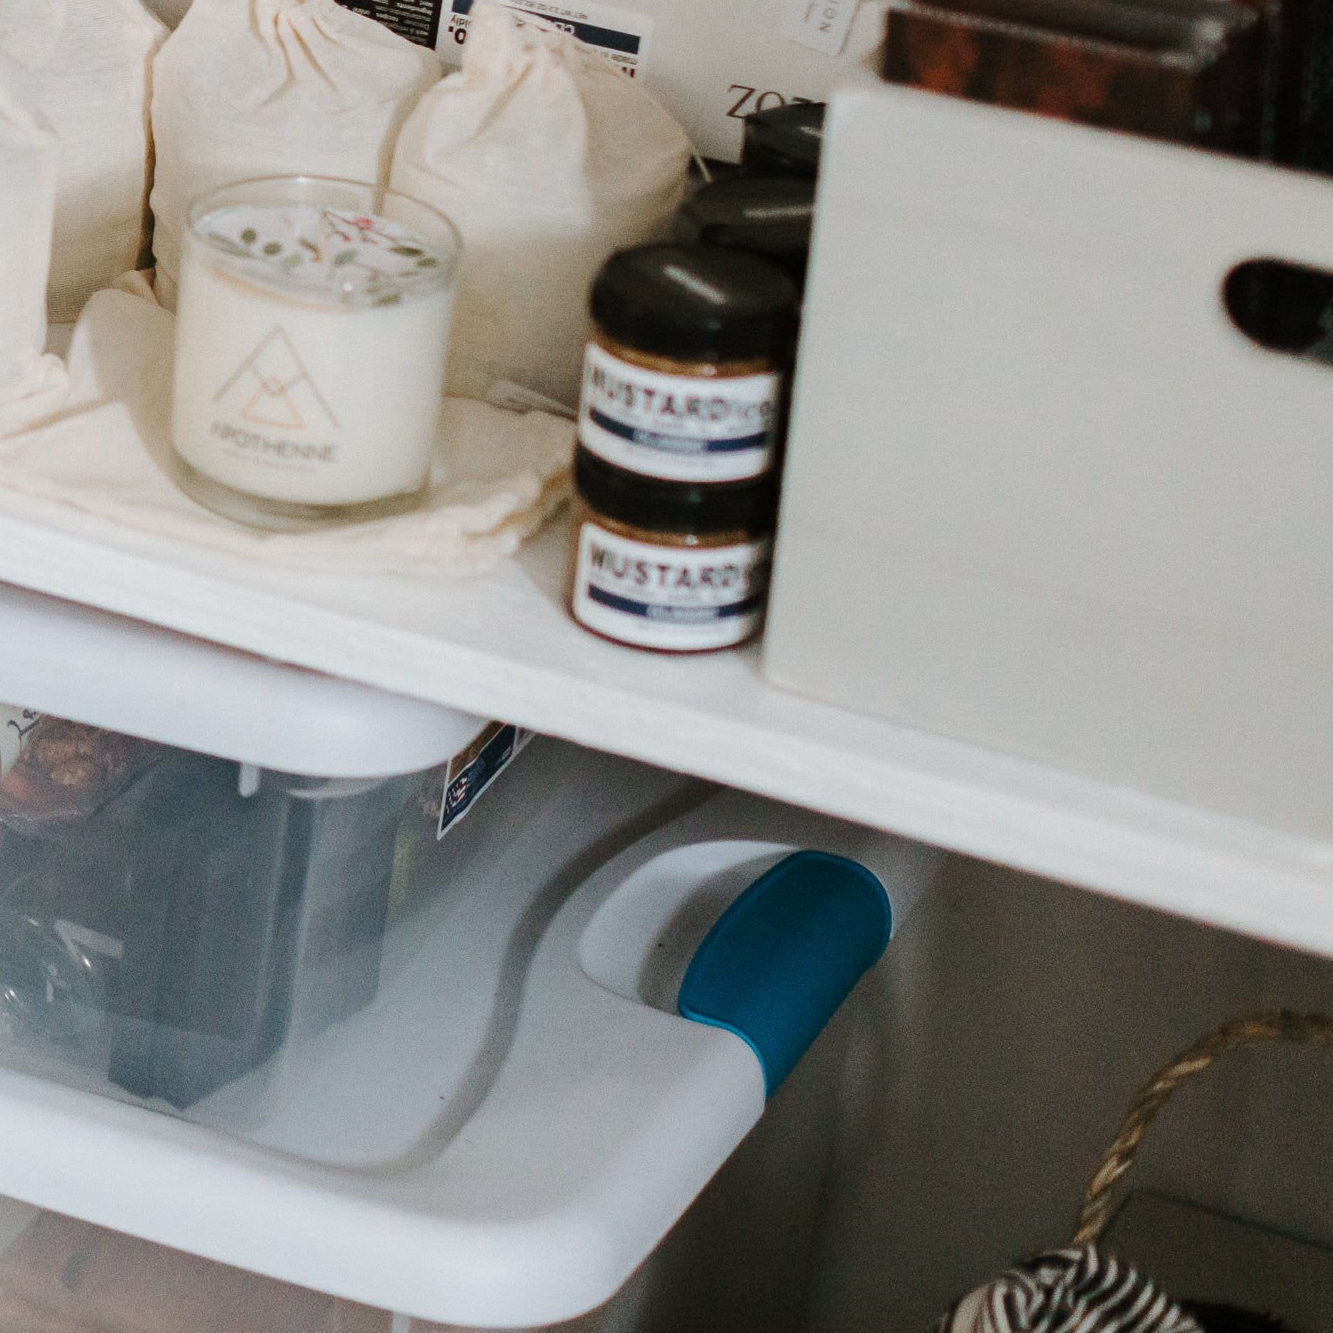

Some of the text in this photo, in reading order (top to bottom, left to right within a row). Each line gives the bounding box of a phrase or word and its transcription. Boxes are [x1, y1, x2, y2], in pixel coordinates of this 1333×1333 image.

[726, 83, 813, 119] ZO
[590, 366, 728, 421] MUSTARD
[589, 541, 743, 589] MUSTARD
